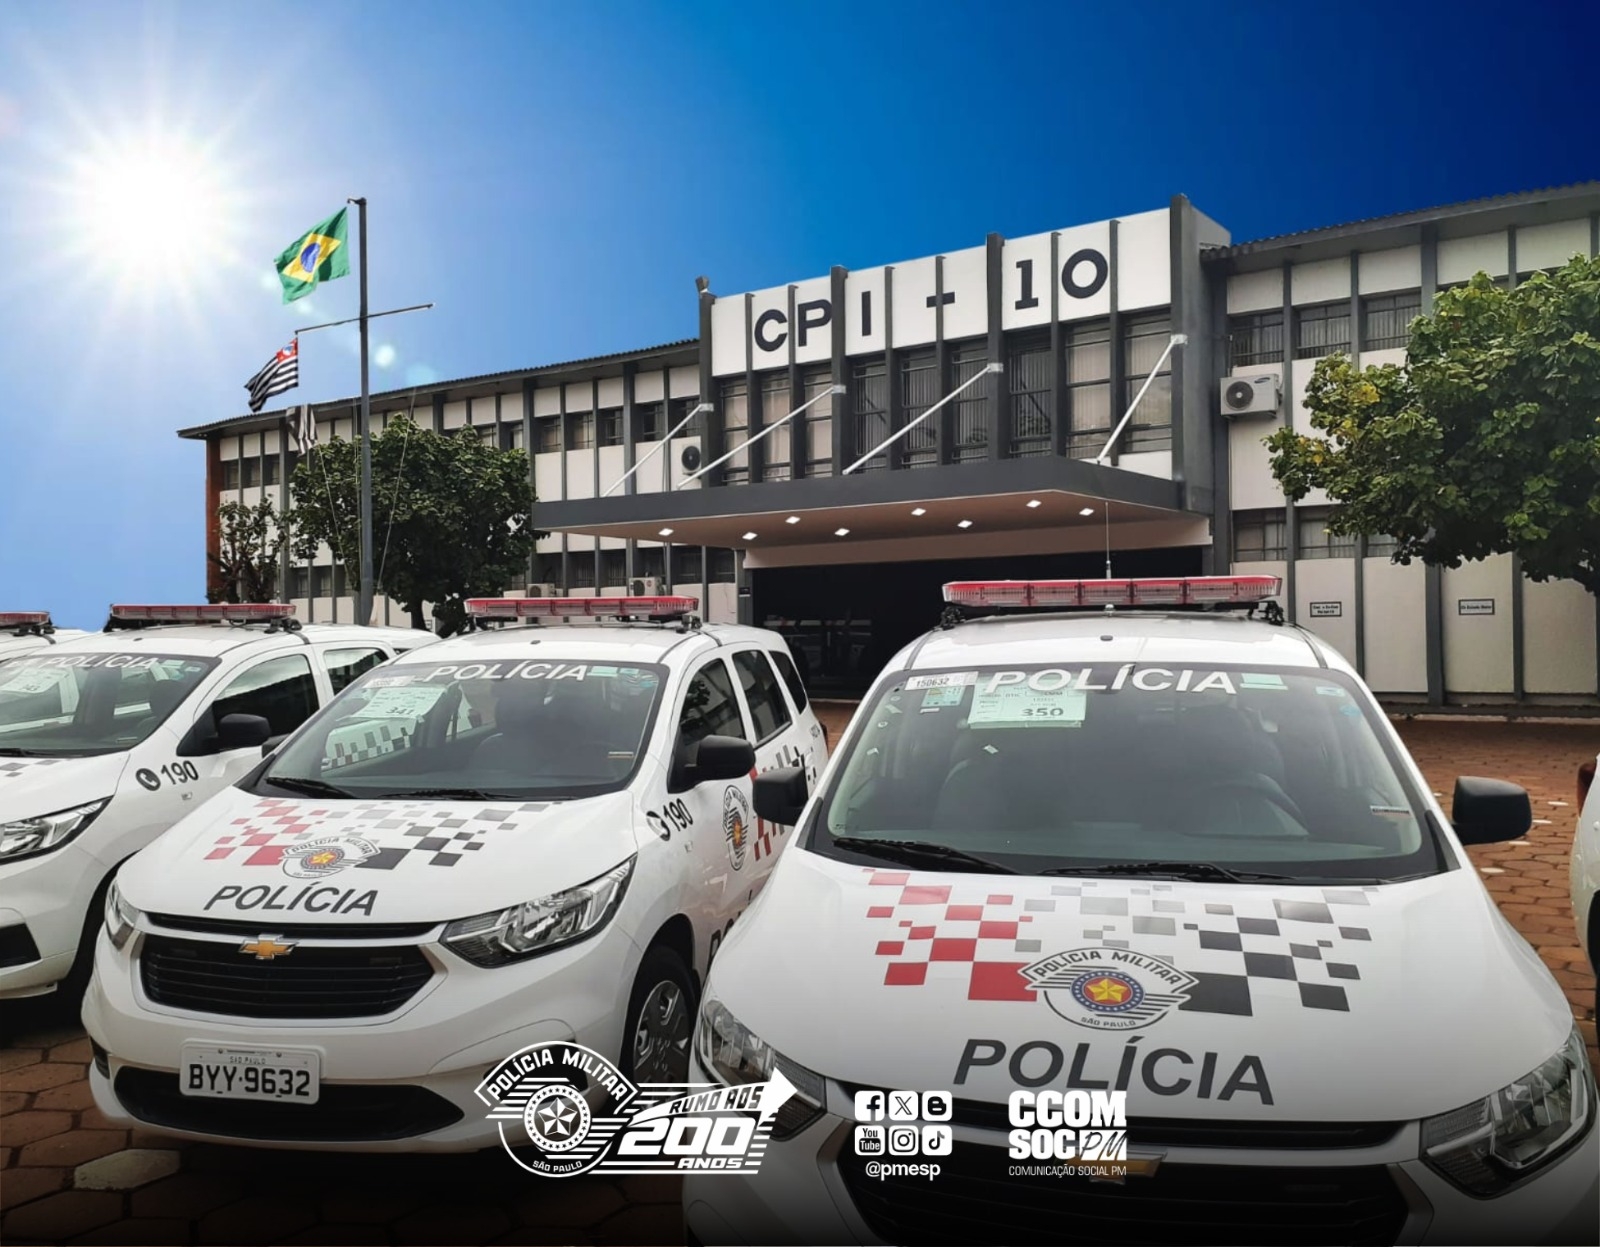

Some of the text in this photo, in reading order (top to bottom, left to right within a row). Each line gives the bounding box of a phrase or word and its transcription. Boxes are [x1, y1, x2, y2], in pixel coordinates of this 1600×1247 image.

[754, 290, 872, 352] CPI
[1015, 248, 1109, 311] 10
[38, 653, 160, 669] POLÍCIA
[423, 661, 588, 682] POLÍCIA
[985, 664, 1238, 695] POLÍCIA
[1021, 707, 1064, 717] 350
[160, 760, 199, 786] 190
[663, 798, 694, 832] 190
[203, 881, 378, 917] POLÍCIA
[1033, 950, 1182, 985] POLÍCIA MILITAR
[1081, 1016, 1136, 1028] SÃO PAULO
[953, 1035, 1274, 1106] POLÍCIA
